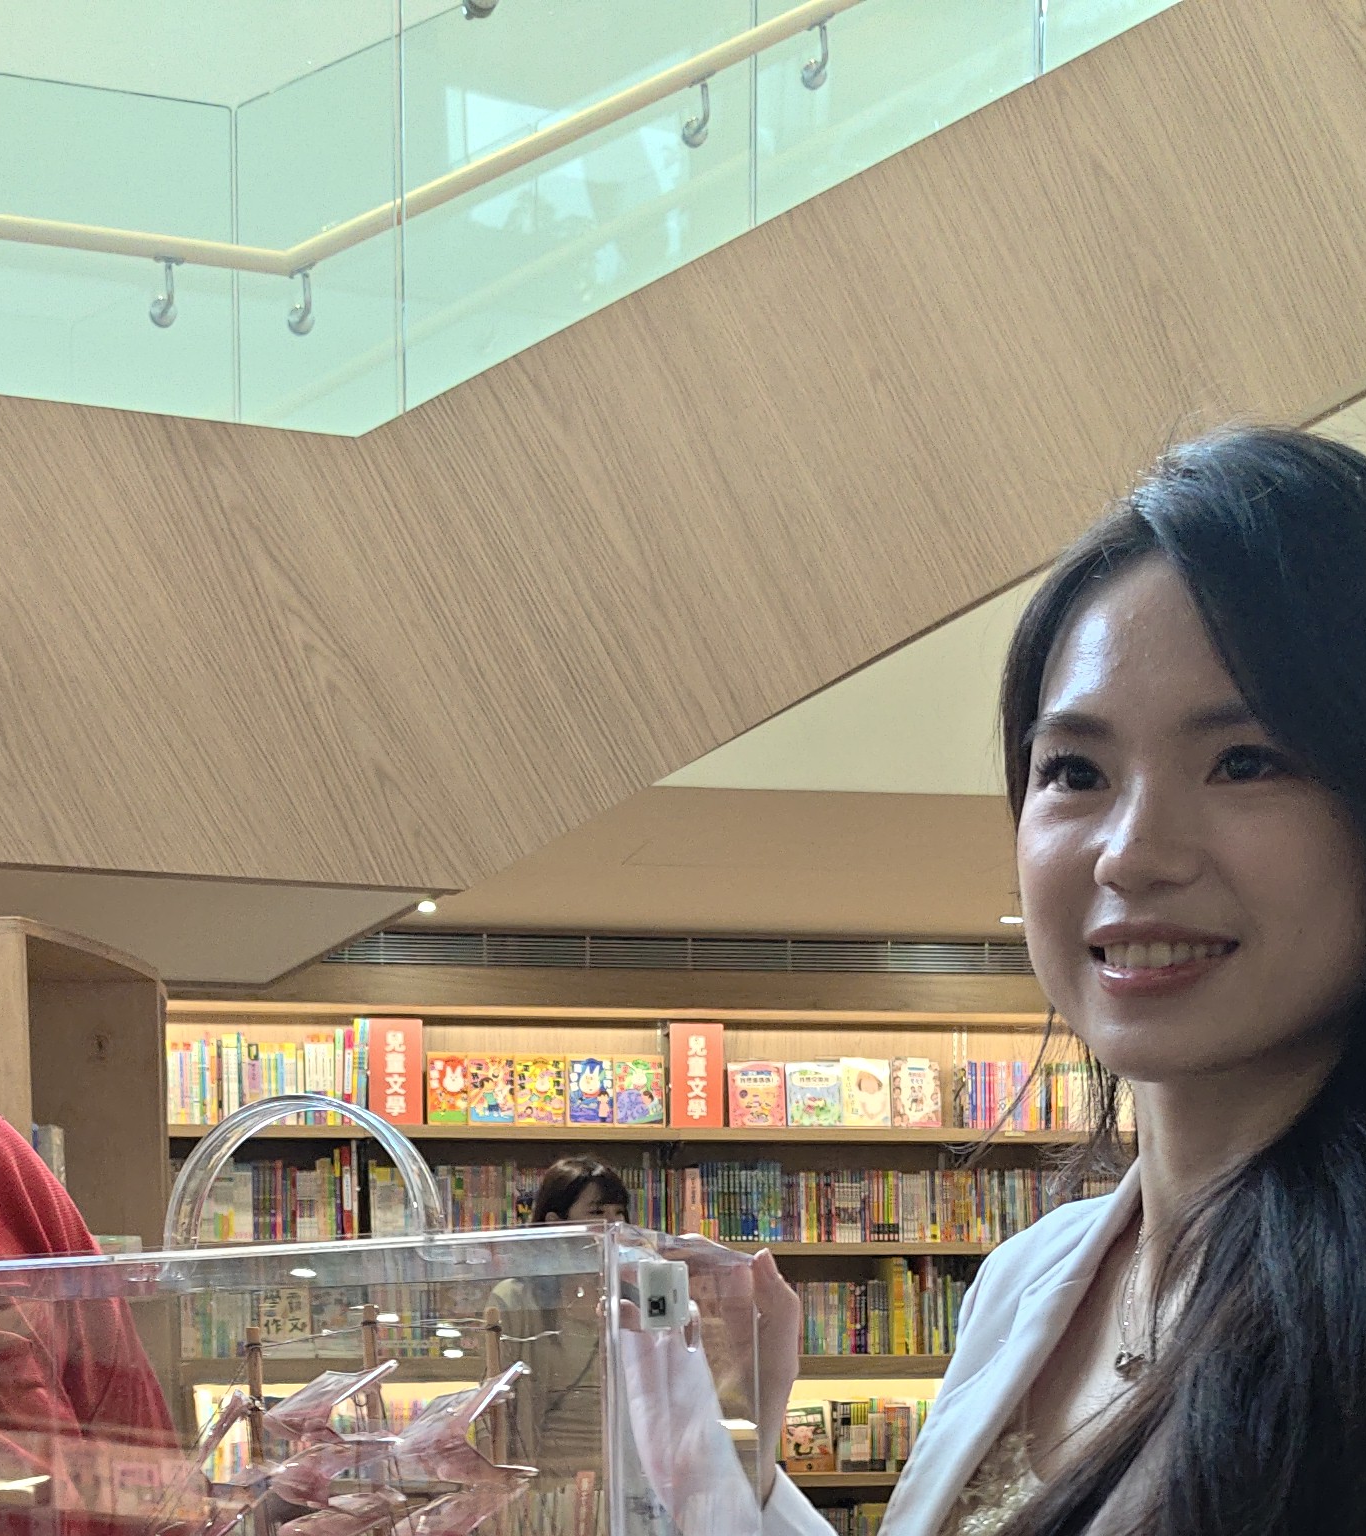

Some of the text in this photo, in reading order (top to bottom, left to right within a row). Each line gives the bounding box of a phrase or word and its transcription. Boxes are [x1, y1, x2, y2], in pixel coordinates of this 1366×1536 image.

[384, 1030, 407, 1118] 兒童文學
[685, 1035, 709, 1120] 兒童文學
